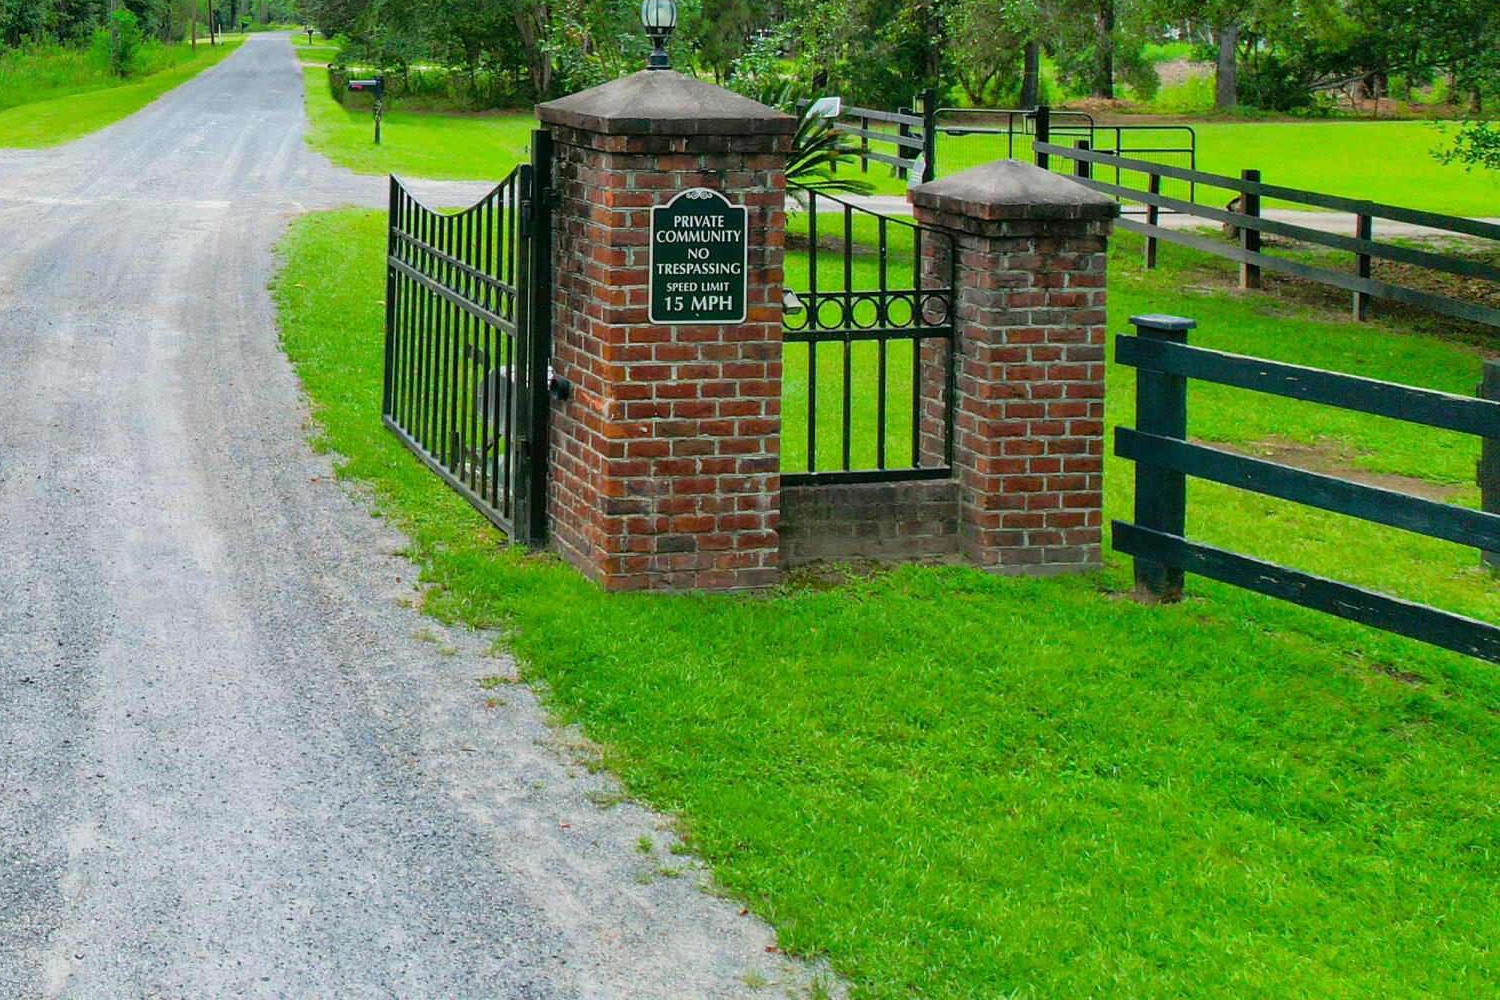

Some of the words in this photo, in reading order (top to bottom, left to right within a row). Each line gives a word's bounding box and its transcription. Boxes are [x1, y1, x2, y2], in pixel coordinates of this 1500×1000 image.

[674, 215, 725, 228] PRIVATE
[656, 230, 741, 243] COMMUNITY
[687, 247, 710, 260] NO
[656, 262, 741, 275] TRESPASSING
[666, 282, 698, 292] SPEED
[701, 282, 730, 292] LIMIT
[664, 296, 684, 311] 15
[690, 295, 733, 311] MPH
